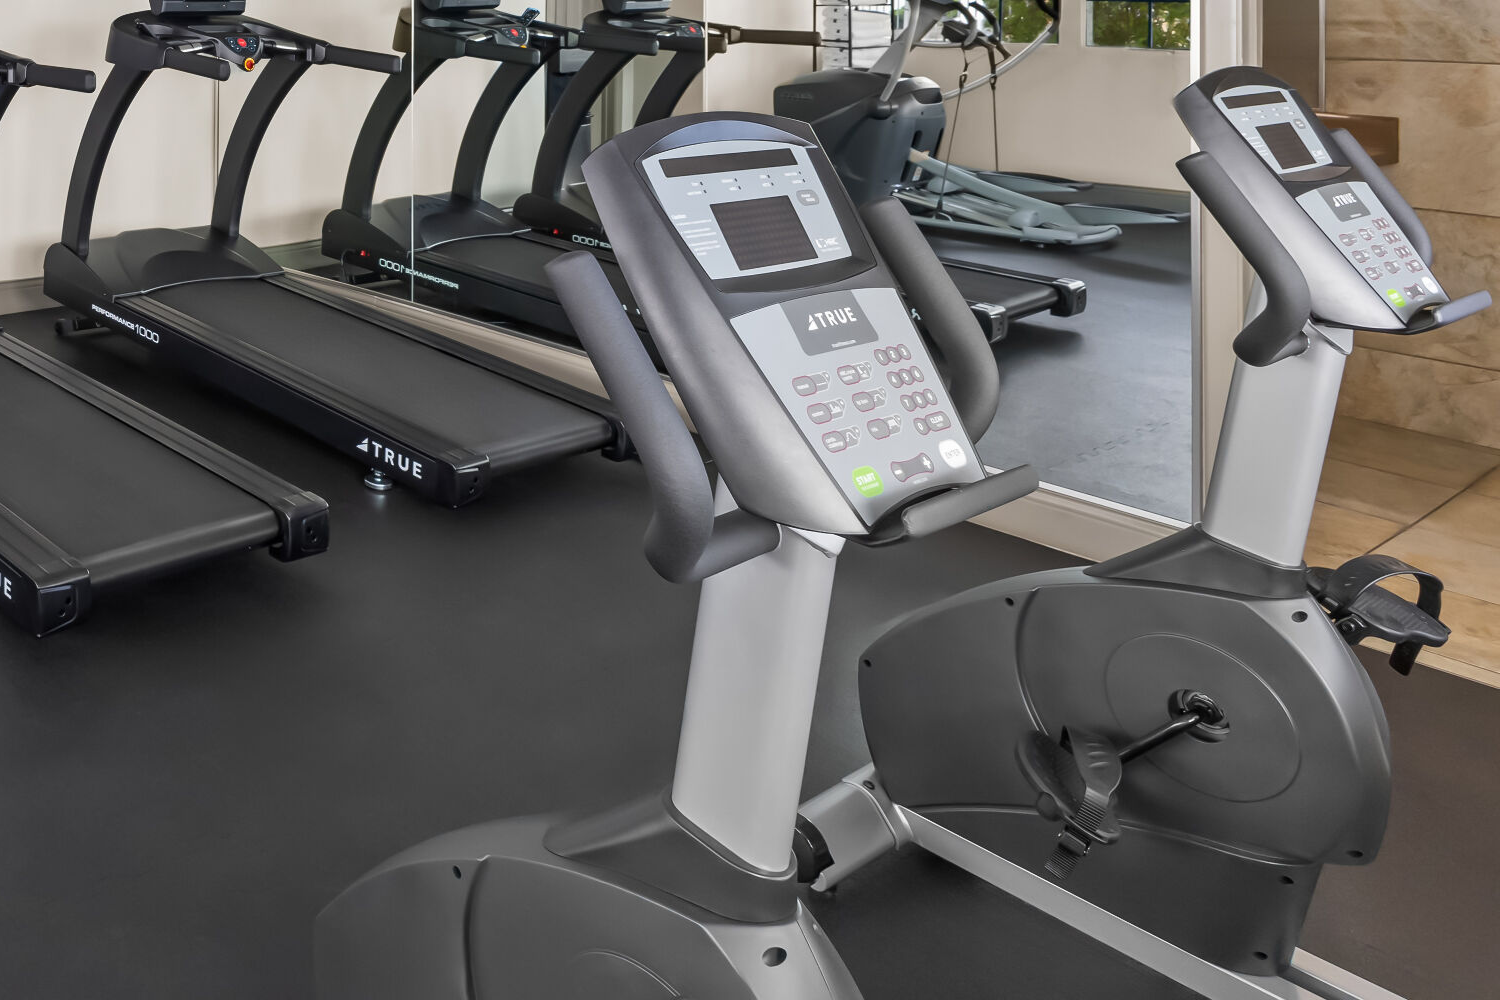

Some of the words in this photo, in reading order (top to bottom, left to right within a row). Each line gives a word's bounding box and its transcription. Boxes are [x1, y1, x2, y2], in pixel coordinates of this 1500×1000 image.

[91, 303, 135, 331] PERFORMANCE
[135, 323, 160, 344] 1000
[814, 307, 857, 328] TRUE
[371, 440, 423, 480] TRUE
[855, 472, 876, 487] START
